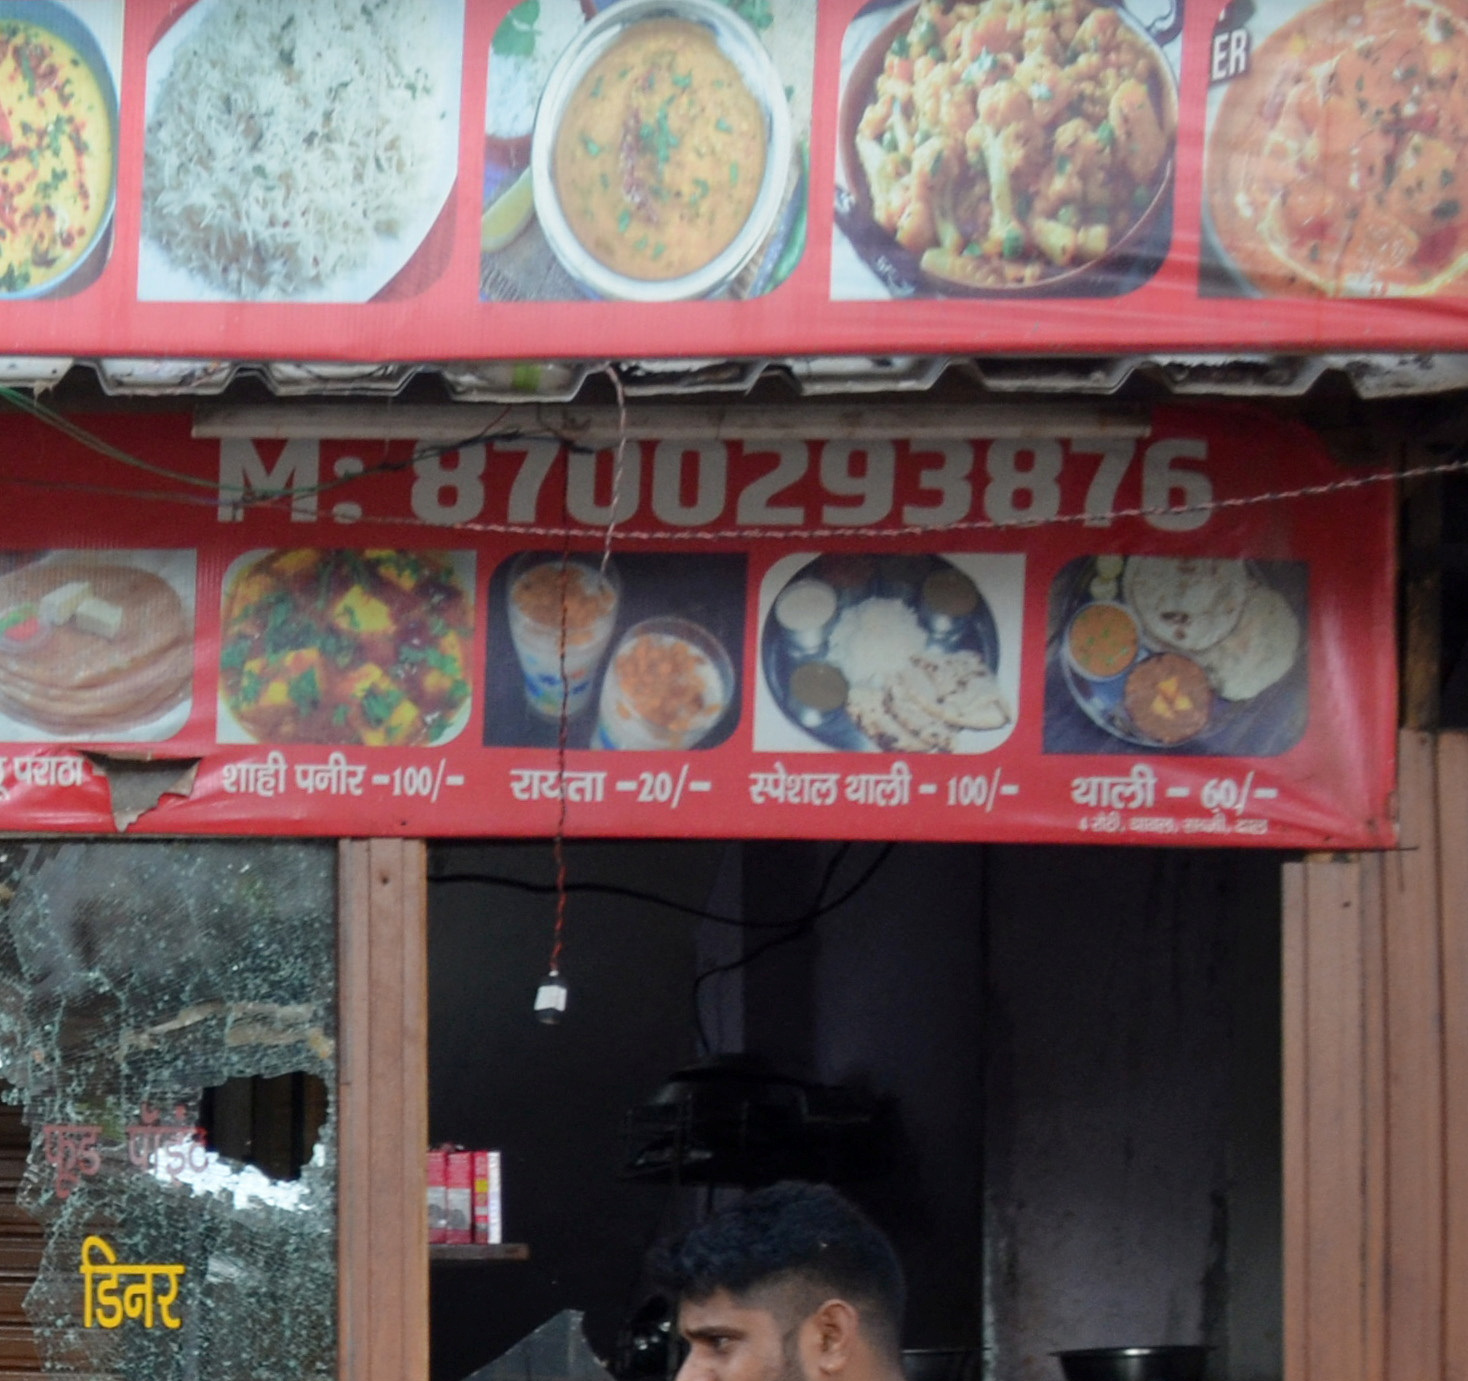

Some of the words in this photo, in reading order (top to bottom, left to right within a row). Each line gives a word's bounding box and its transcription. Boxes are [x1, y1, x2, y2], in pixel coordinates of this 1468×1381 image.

[411, 438, 1213, 533] 8700293876
[221, 750, 288, 797] शाही
[294, 751, 365, 796] पनीर
[509, 768, 606, 804] रायता
[749, 760, 839, 807] स्पेशल
[845, 759, 911, 808] थाली
[1070, 763, 1158, 808] थाली
[78, 1235, 186, 1330] डिनर
